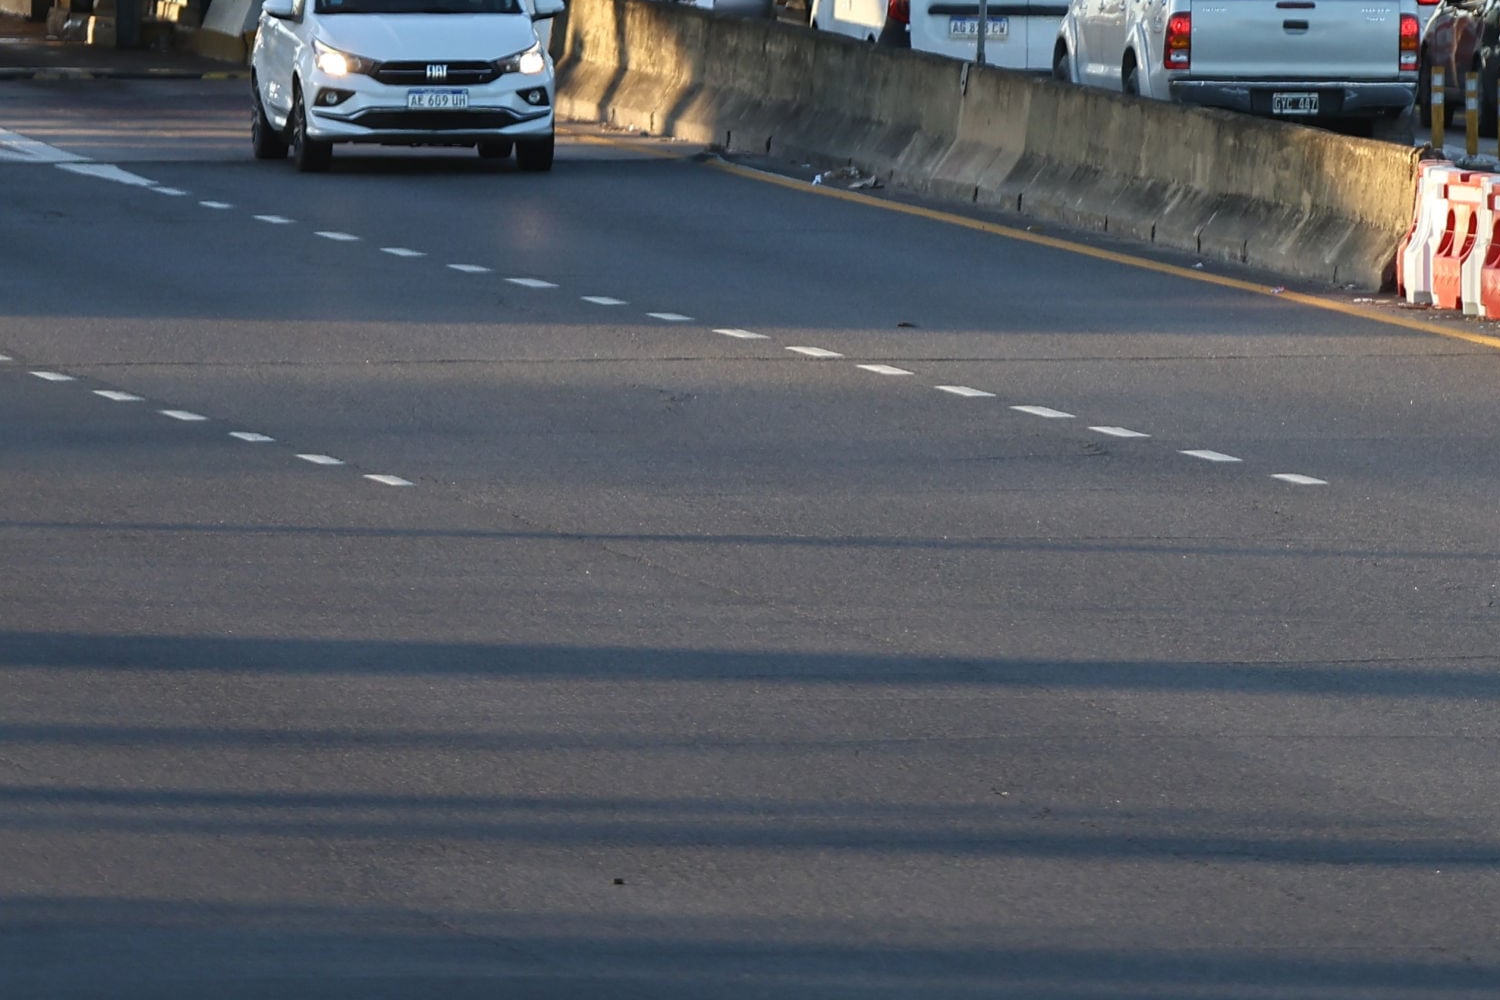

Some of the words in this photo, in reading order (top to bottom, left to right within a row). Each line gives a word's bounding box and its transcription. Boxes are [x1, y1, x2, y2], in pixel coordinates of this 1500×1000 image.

[426, 64, 448, 78] FIAT
[410, 94, 424, 107] AE
[428, 94, 448, 107] 609
[451, 95, 466, 107] UH
[1299, 98, 1317, 111] 447
